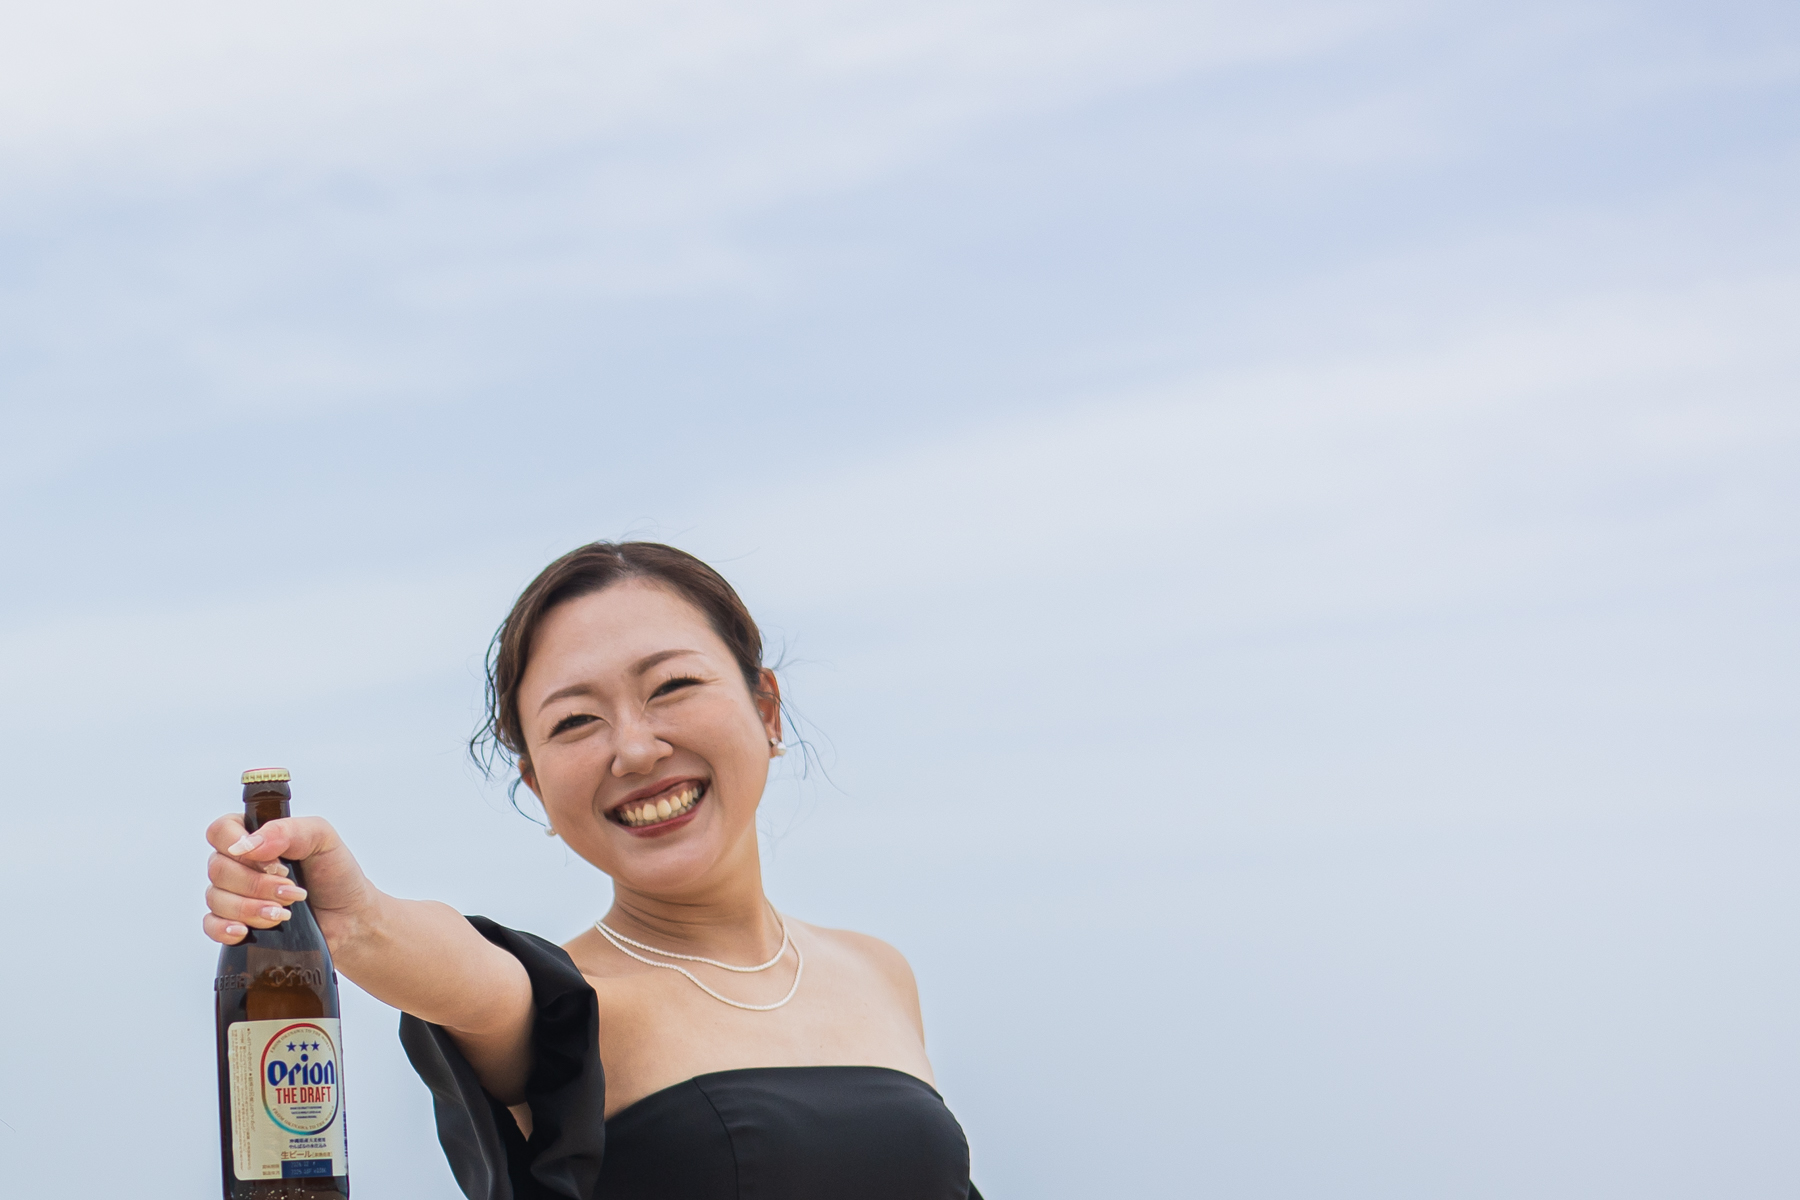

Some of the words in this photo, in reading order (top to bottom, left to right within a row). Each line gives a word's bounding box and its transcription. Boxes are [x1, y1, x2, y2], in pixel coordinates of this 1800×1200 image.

[267, 1053, 335, 1086] Orion
[275, 1087, 298, 1104] THE
[300, 1086, 331, 1103] DRAFT
[281, 1150, 312, 1159] 生ビール
